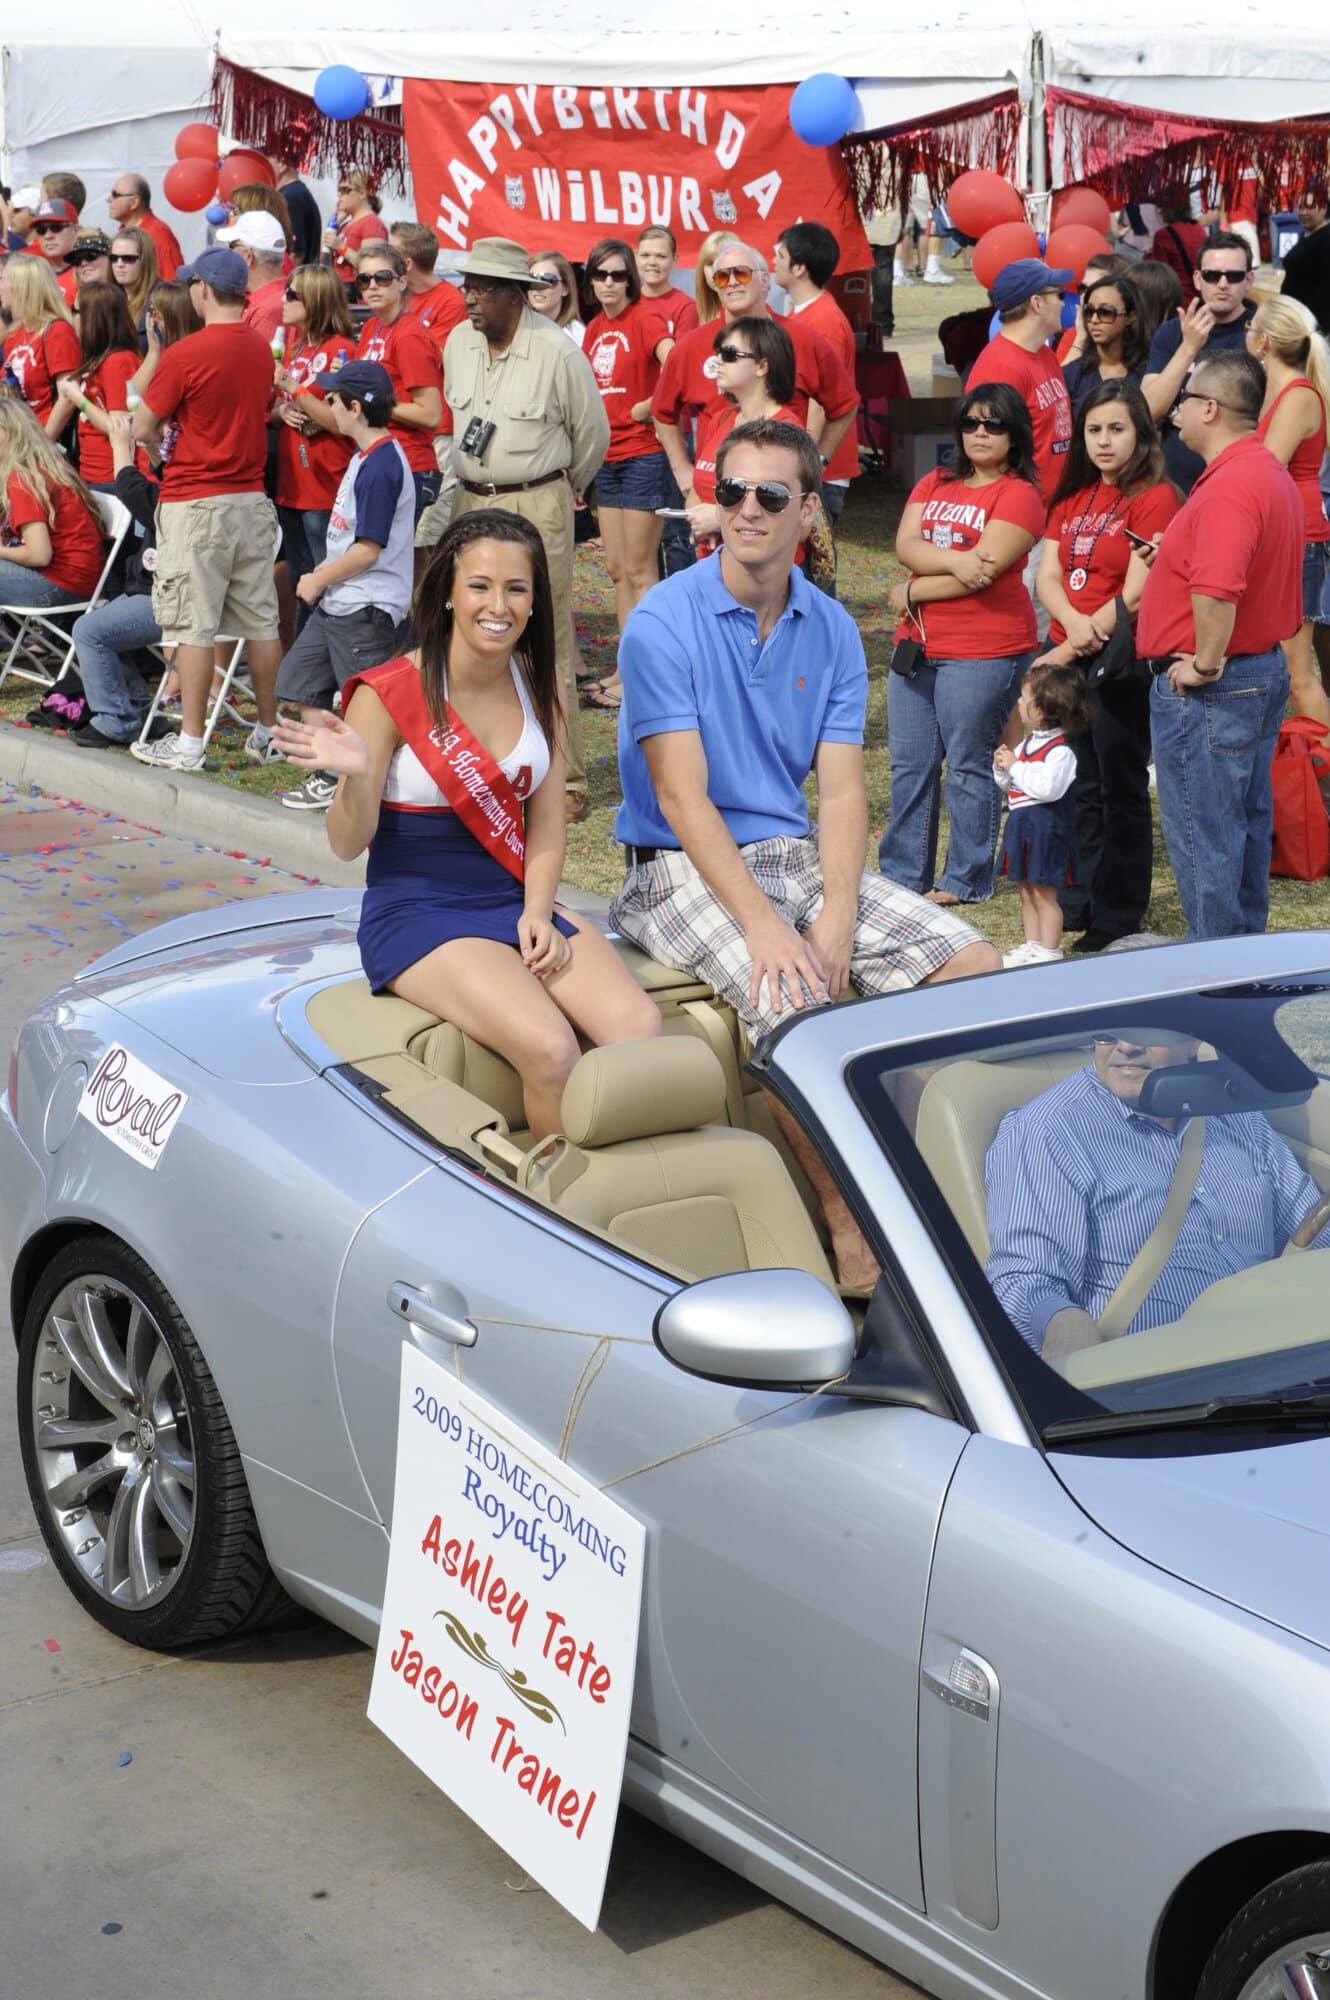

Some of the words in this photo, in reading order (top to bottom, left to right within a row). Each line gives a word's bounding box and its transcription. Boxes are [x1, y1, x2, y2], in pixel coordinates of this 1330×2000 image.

[437, 85, 542, 248] HAPPY
[449, 750, 511, 838] Homecoming
[88, 1049, 182, 1146] Royal
[413, 1386, 462, 1442] 2009
[465, 1426, 626, 1577] HOMECOMING
[461, 1464, 567, 1581] Royalty
[421, 1514, 529, 1648] Ashley
[542, 1610, 611, 1704] Tate
[390, 1629, 479, 1742] Jason
[490, 1716, 597, 1841] Tranel
